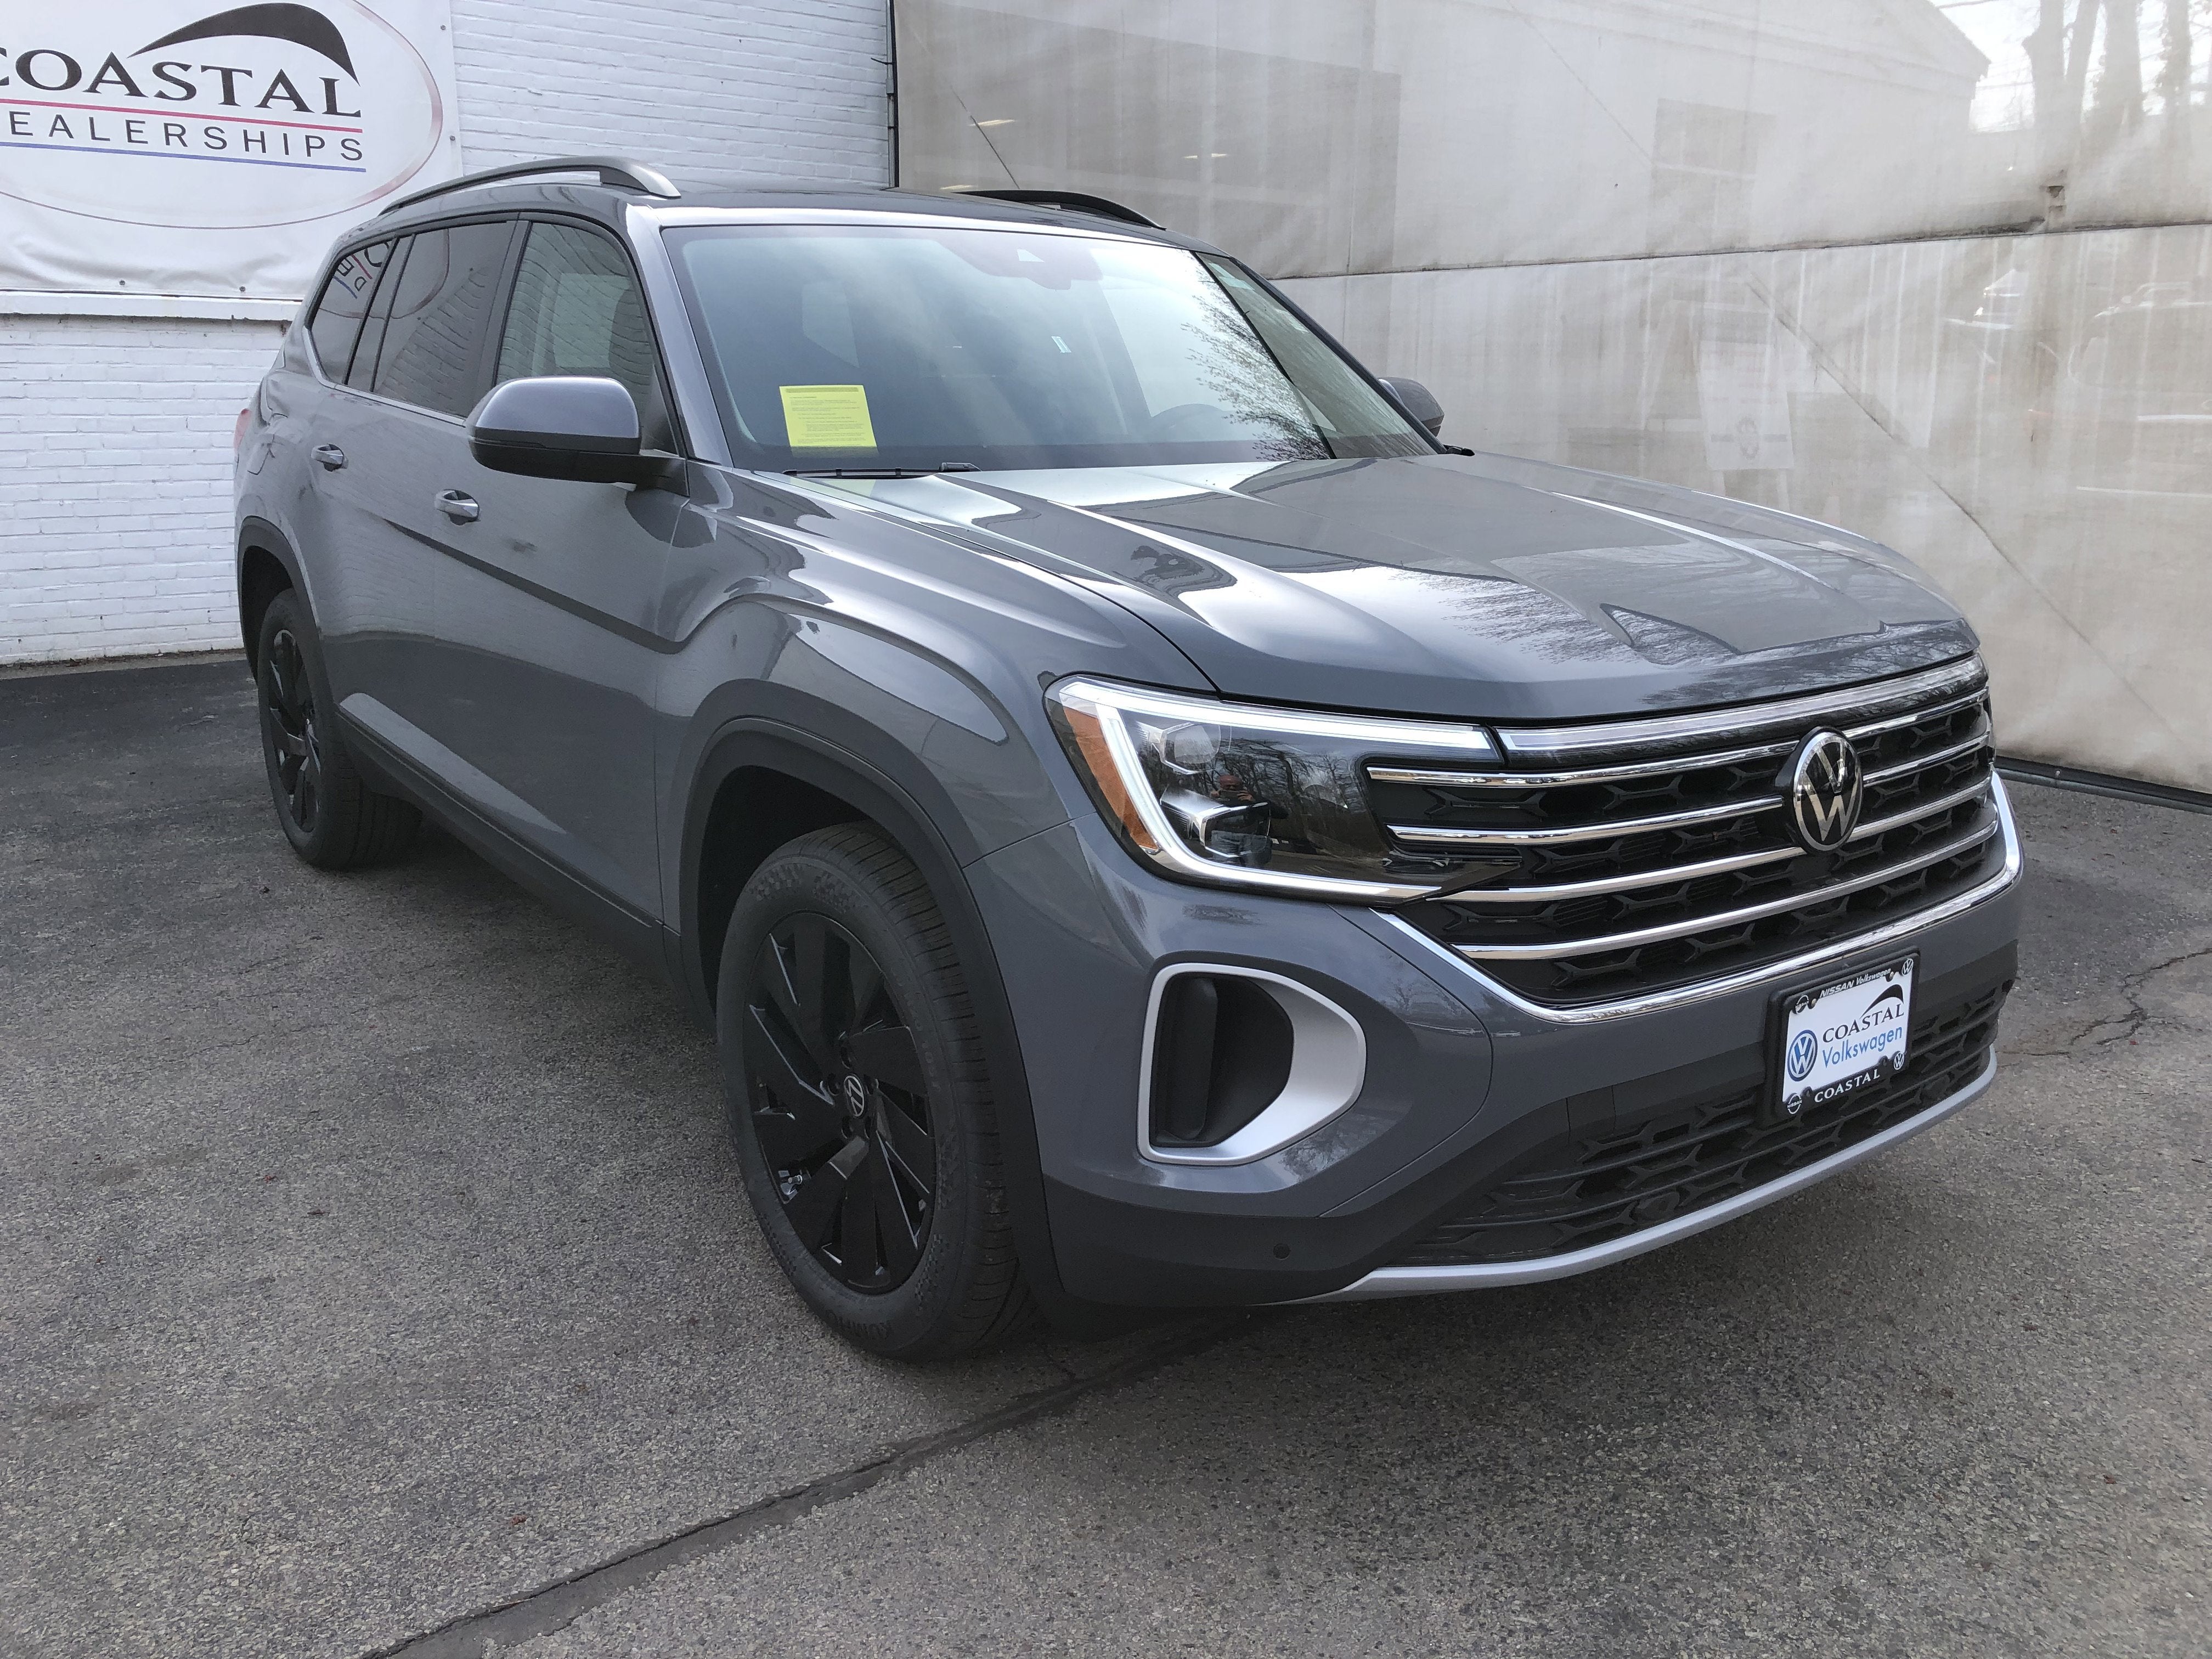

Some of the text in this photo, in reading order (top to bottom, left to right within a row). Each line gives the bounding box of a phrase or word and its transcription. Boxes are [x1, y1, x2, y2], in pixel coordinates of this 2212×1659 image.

[0, 47, 362, 118] OASTAL
[9, 110, 363, 161] EALERSHIPS
[1819, 968, 1892, 997] NISSAN Volkswagen
[1822, 1004, 1905, 1043] COASTAL
[1822, 1026, 1903, 1068] Volkswagen
[1814, 1069, 1880, 1103] COASTAL
